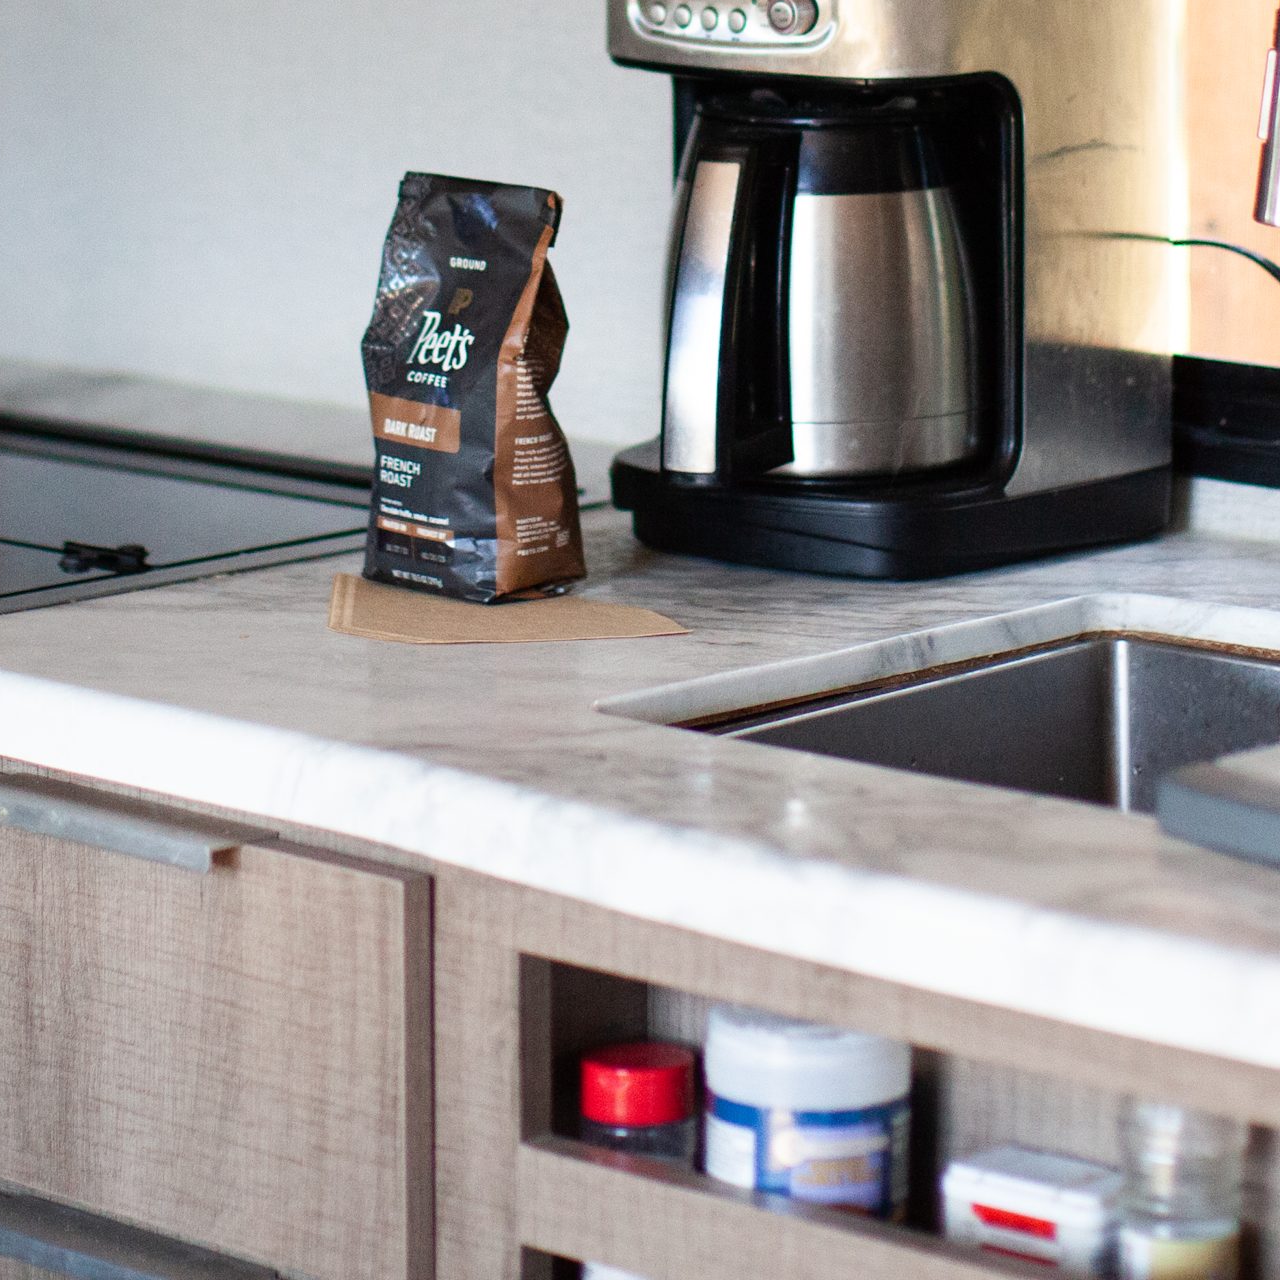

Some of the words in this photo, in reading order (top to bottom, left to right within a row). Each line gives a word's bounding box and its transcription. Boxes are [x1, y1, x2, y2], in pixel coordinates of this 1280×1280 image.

[449, 257, 487, 271] GROUND
[406, 310, 475, 372] Peet's
[406, 371, 448, 388] COFFEE
[384, 418, 407, 437] DARK
[407, 423, 437, 443] ROAST
[380, 455, 421, 475] FRENCH
[380, 470, 413, 488] ROAST
